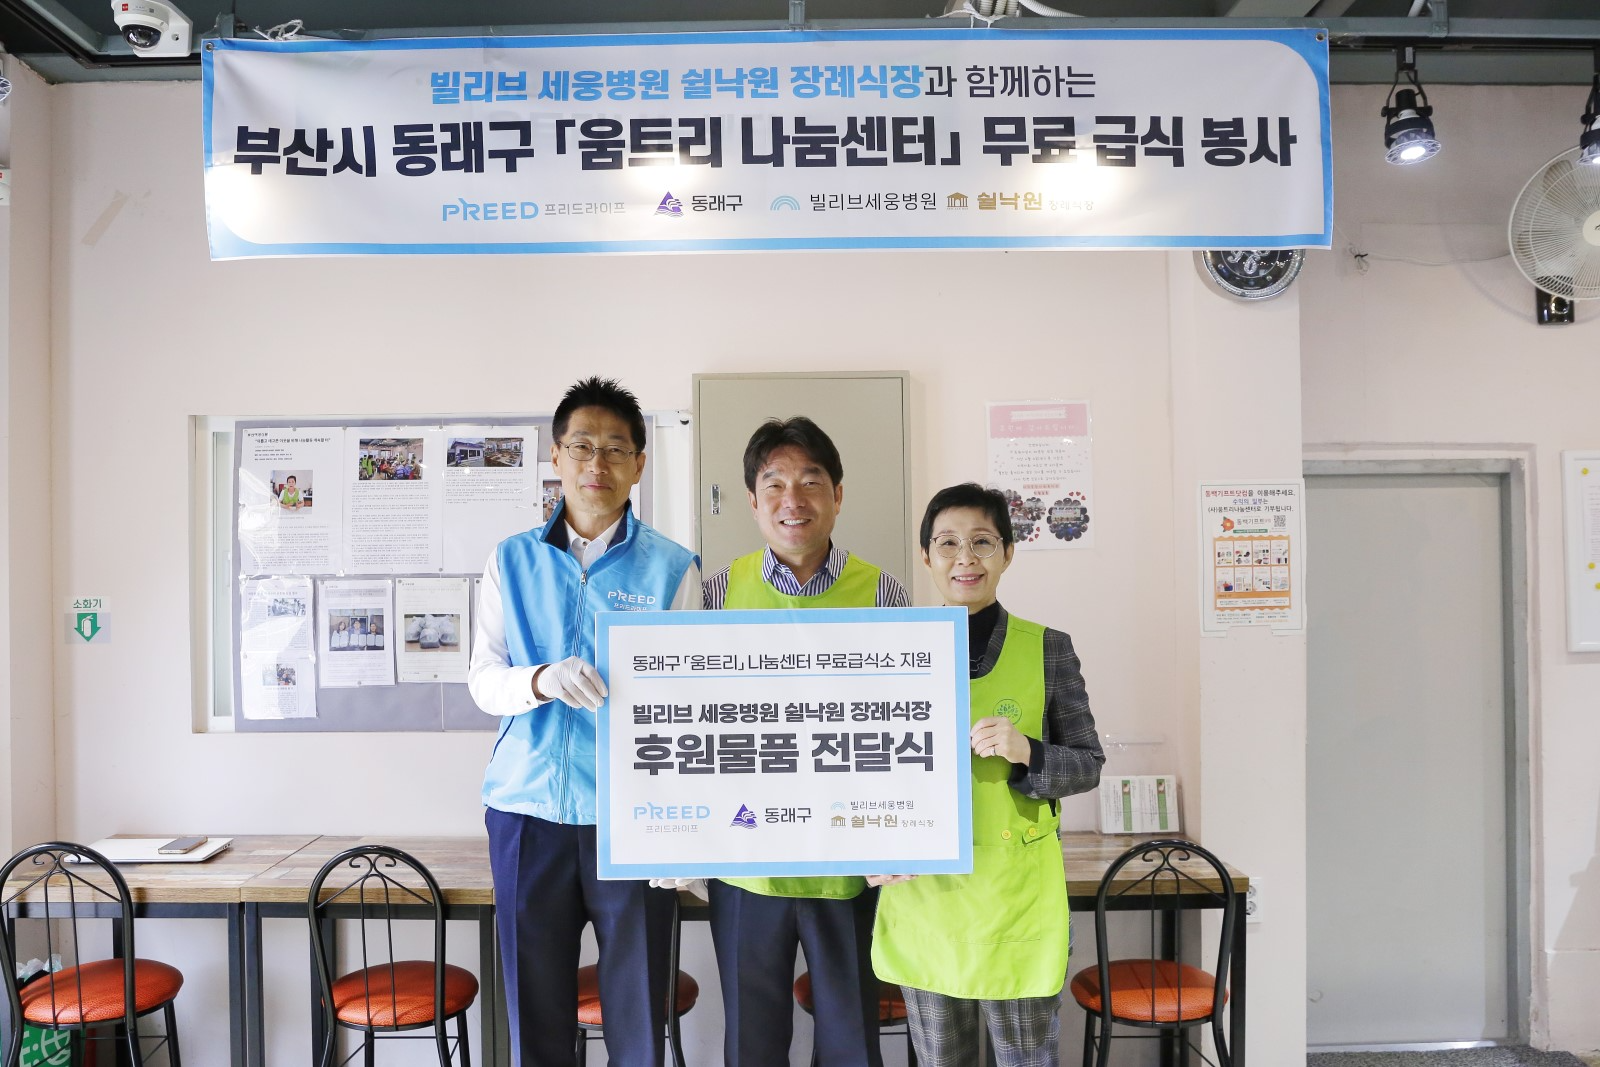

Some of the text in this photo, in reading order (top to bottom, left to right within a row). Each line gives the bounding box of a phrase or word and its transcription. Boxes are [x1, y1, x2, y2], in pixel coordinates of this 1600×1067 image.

[430, 64, 1097, 105] 빌리브 세웅병원 쉴낙원 장례식장과 함께하는
[233, 125, 377, 178] 부산시
[392, 119, 536, 177] 동래구
[982, 115, 1078, 168] 무료
[1092, 115, 1185, 168] 급식
[1201, 115, 1298, 168] 봉사
[442, 197, 540, 222] PREED
[544, 201, 628, 216] 프리드라이프
[691, 194, 744, 213] 동래구
[809, 192, 938, 212] 빌리브세웅병원
[977, 191, 1095, 211] 쉴낙원 장례식장
[73, 598, 102, 609] 소화기
[607, 589, 656, 605] PREED
[632, 654, 681, 672] 동래구
[748, 653, 812, 671] 나눔센터
[815, 652, 896, 670] 무료급식소
[900, 651, 932, 669] 지원
[632, 700, 932, 725] 빌리브 세웅병원 쉴낙원 장례식장
[633, 731, 934, 776] 후원물품 전달식
[633, 801, 711, 821] PREED
[764, 807, 812, 824] 동래구
[850, 800, 915, 811] 빌리브세웅병원
[645, 824, 700, 834] 프리드라이프
[850, 814, 935, 829] 쉴낙원 장례식장
